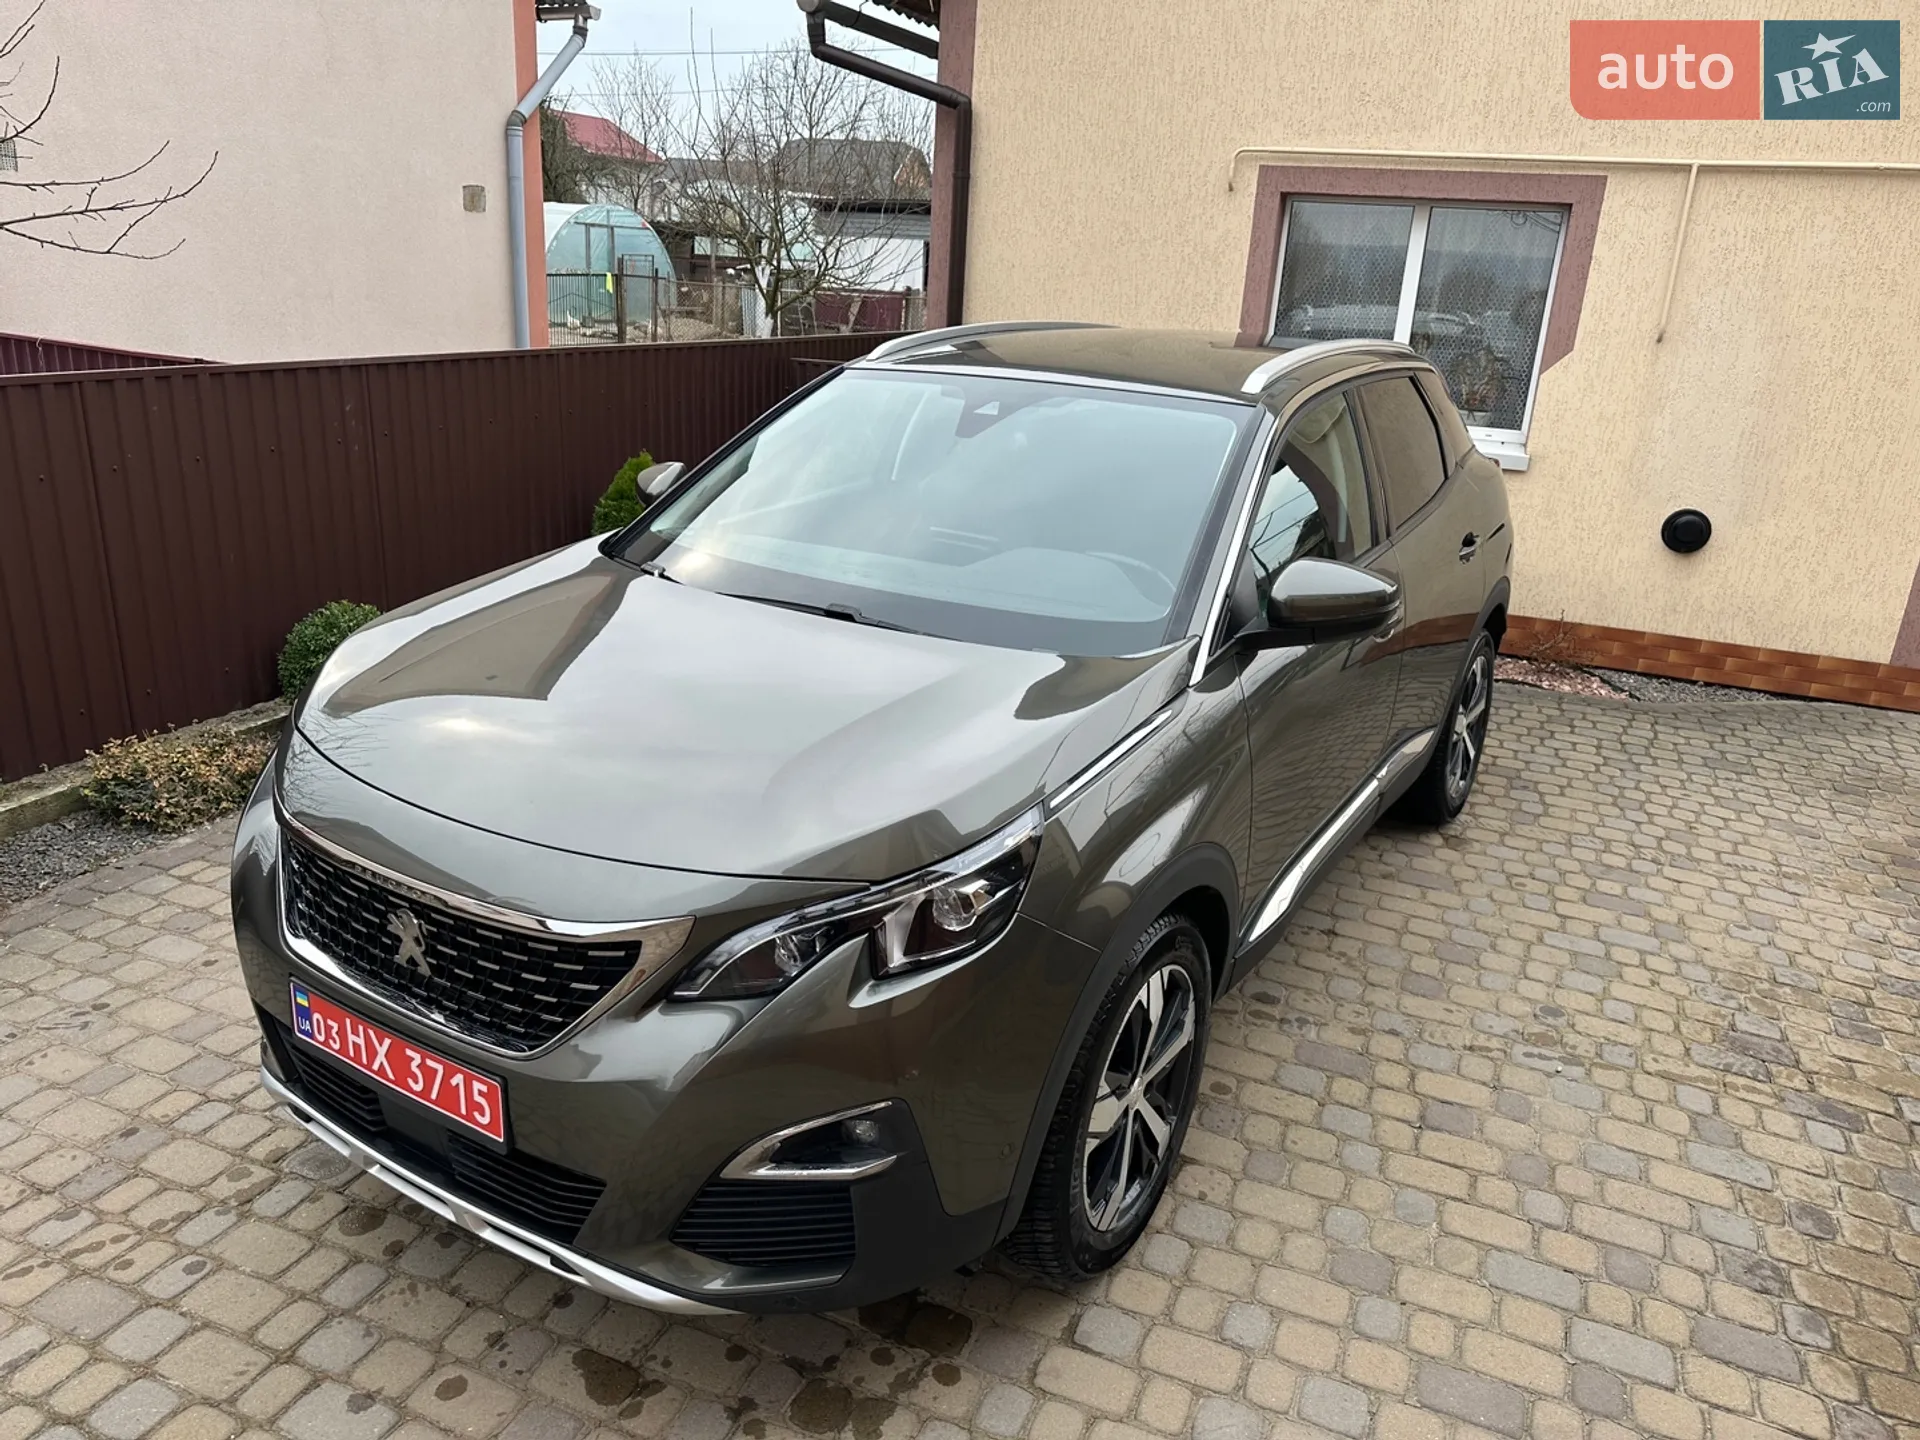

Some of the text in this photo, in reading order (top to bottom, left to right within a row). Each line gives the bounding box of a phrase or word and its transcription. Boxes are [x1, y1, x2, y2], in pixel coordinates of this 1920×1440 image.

[298, 1016, 312, 1034] UA
[312, 1013, 491, 1126] 03 HX 3715
